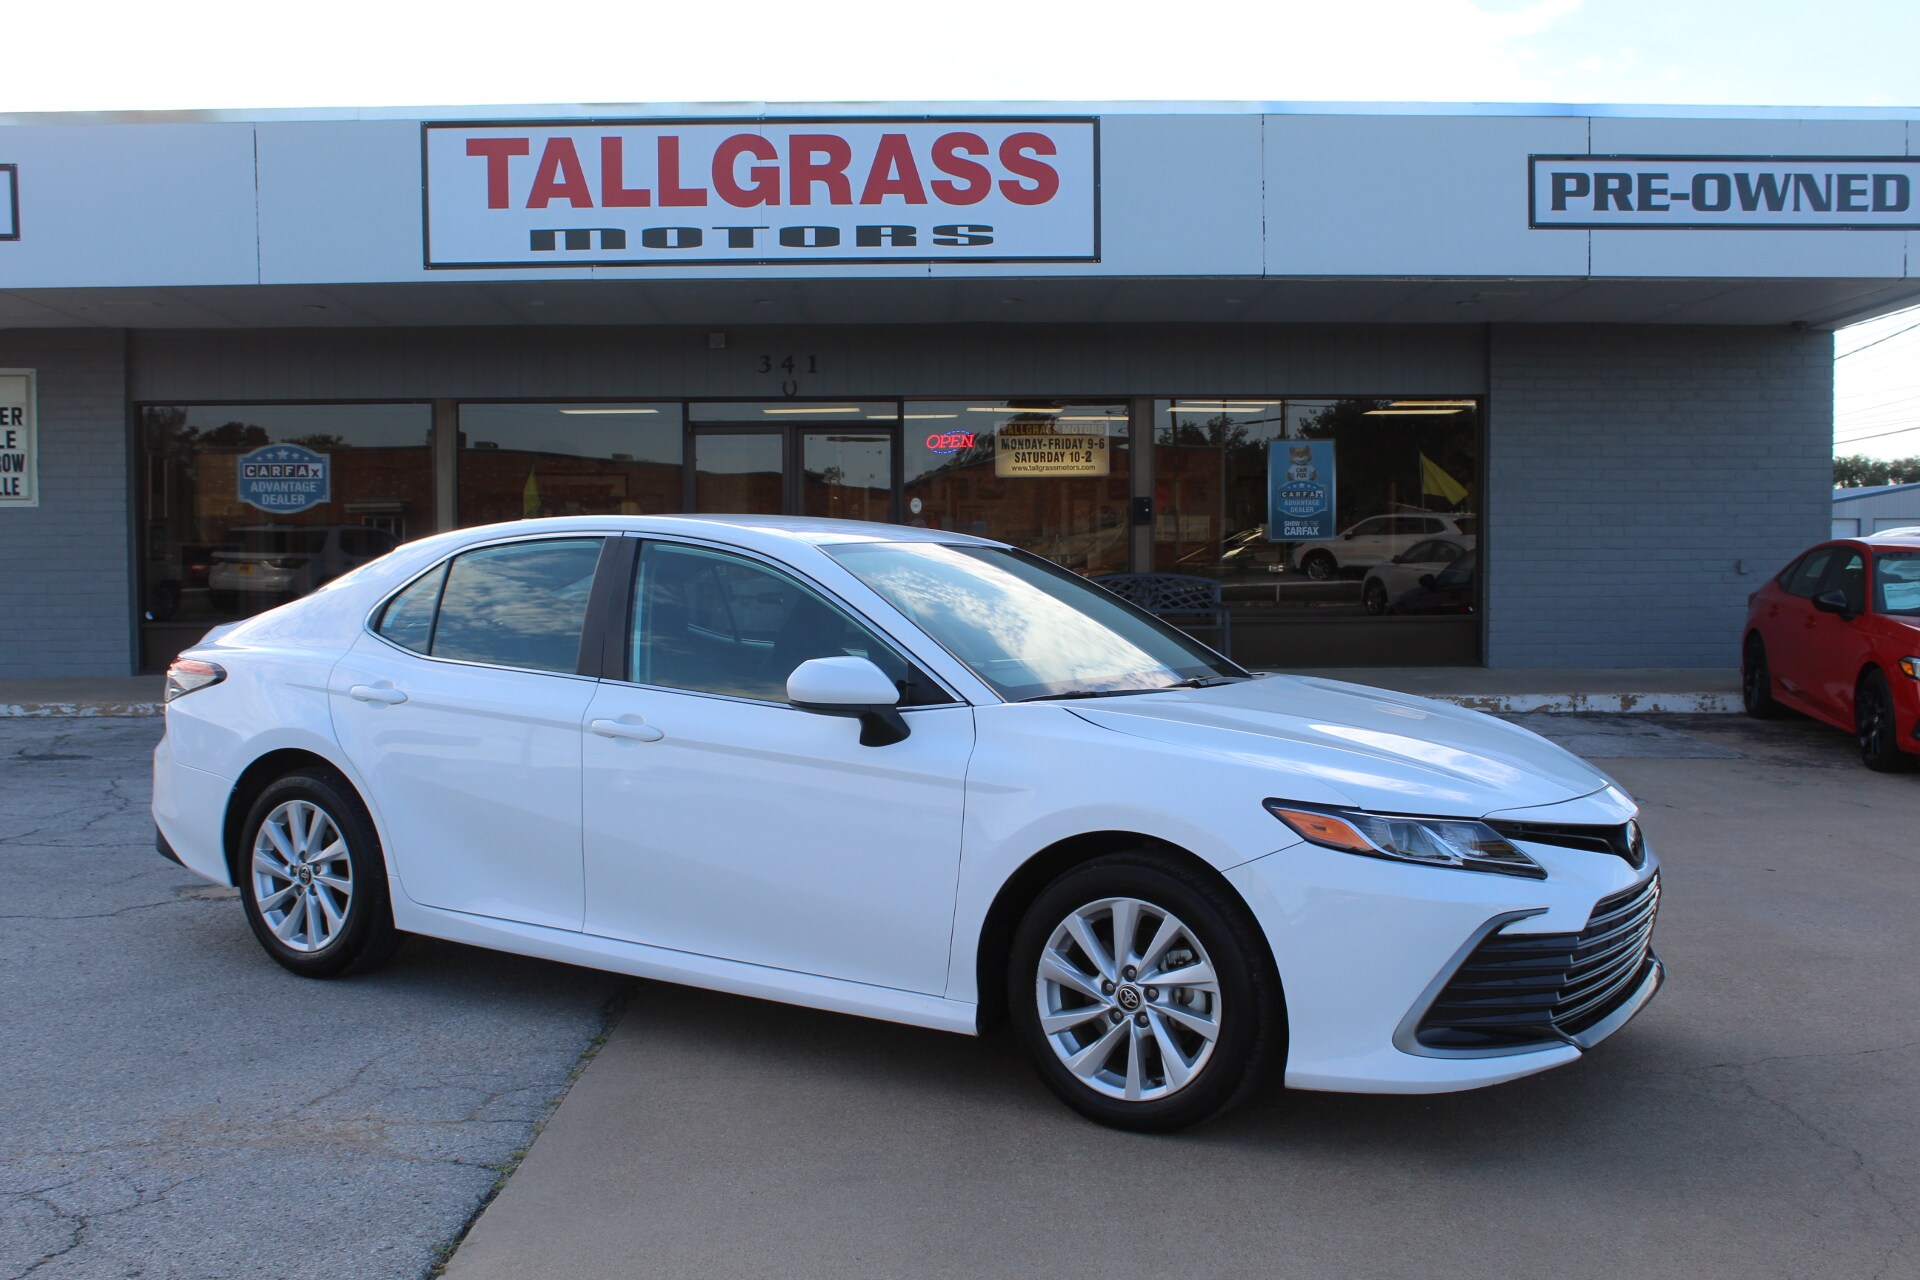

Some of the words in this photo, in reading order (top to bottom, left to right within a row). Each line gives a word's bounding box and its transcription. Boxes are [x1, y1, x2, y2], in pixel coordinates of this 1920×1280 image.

[466, 131, 1060, 209] TALLGRASS
[1551, 172, 1910, 212] PRE-OWNED
[1001, 424, 1059, 435] TALLGRASS
[1062, 424, 1104, 435] MOTORS
[926, 433, 976, 449] OPEN
[1001, 438, 1084, 450] MONDAY-FRIDAY
[1087, 438, 1105, 450] 9-6
[0, 453, 25, 473] OW
[1014, 451, 1066, 463] SATURDAY
[1069, 451, 1092, 463] 10-2
[245, 465, 321, 478] CARFAX
[1011, 464, 1096, 473] www.tallgrassmotors.com
[250, 481, 317, 492] ADVANTAGE
[262, 494, 305, 505] DEALER
[1284, 527, 1319, 536] CARFAX
